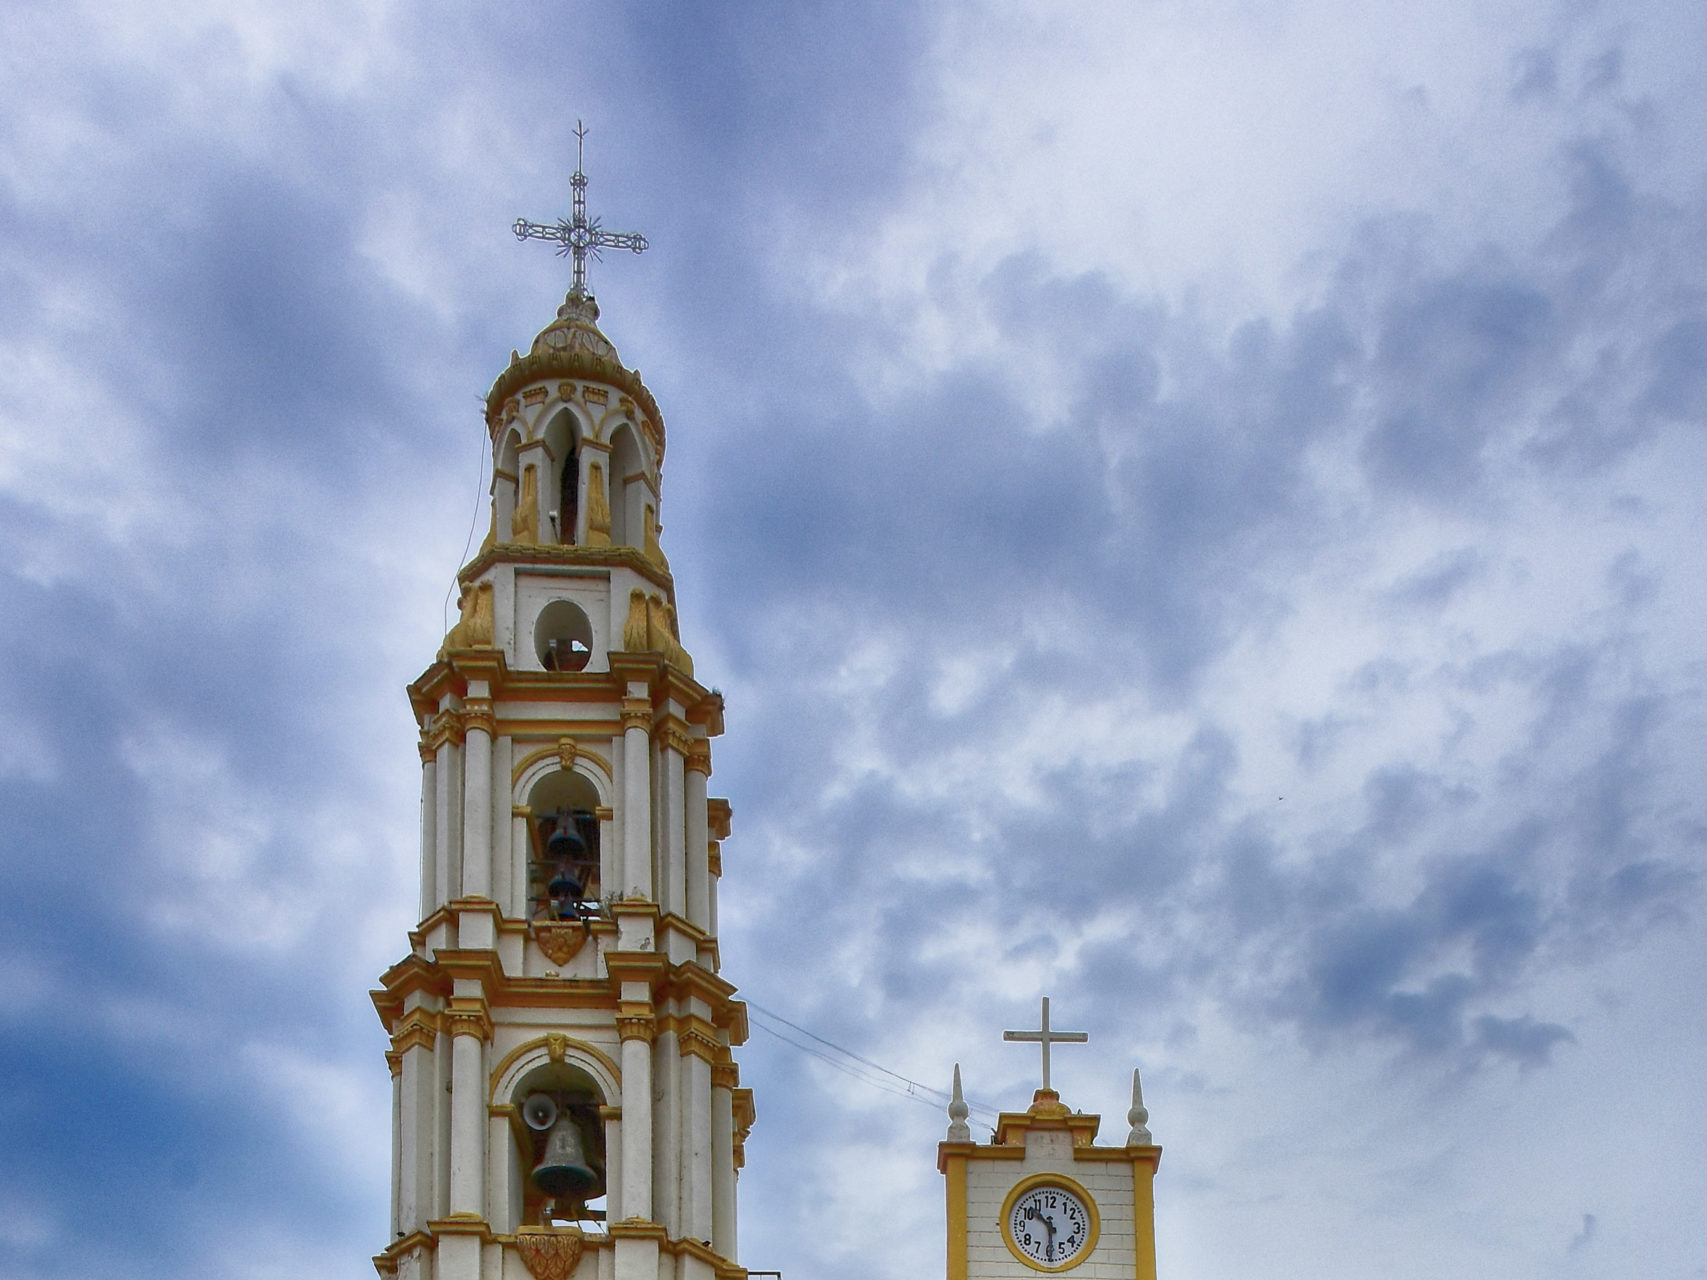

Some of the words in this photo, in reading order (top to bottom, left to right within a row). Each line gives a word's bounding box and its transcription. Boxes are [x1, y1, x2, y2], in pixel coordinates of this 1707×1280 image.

[1034, 1199, 1041, 1212] 11
[1045, 1196, 1056, 1209] 12
[1062, 1202, 1067, 1215] 1
[1024, 1207, 1034, 1220] 10
[1069, 1208, 1076, 1220] 2
[1019, 1220, 1025, 1232] 9
[1073, 1222, 1081, 1234] 3
[1023, 1233, 1031, 1246] 8
[1067, 1235, 1076, 1248] 4
[1034, 1241, 1041, 1254] 7
[1058, 1242, 1065, 1254] 5
